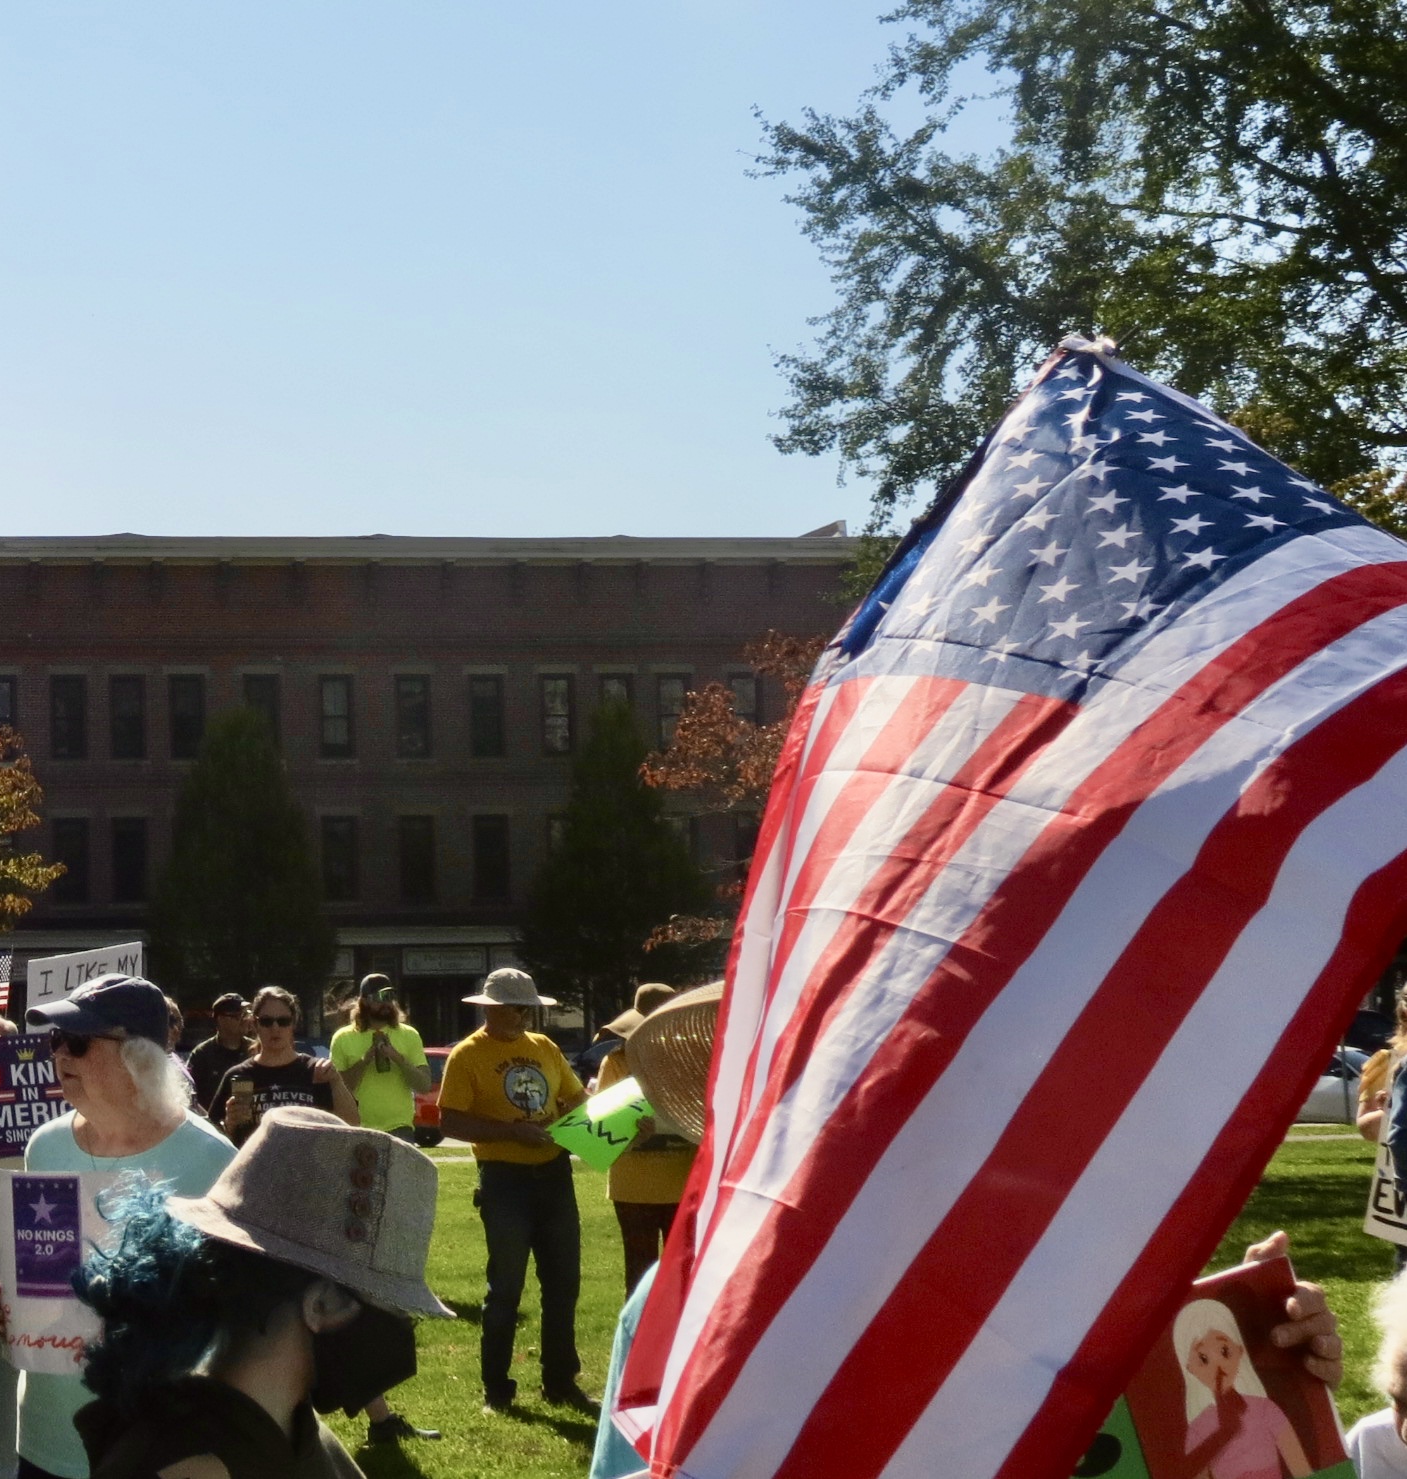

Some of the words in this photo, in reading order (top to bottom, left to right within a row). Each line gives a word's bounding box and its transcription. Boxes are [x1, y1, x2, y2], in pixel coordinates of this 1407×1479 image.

[38, 970, 53, 997] I
[64, 962, 108, 992] LIKE
[117, 954, 138, 978] MY
[10, 1061, 55, 1087] KIN
[22, 1087, 39, 1101] IN
[272, 1091, 314, 1103] NEVER
[17, 1229, 33, 1241] NO
[35, 1229, 75, 1242] KINGS
[35, 1243, 54, 1256] 2.0
